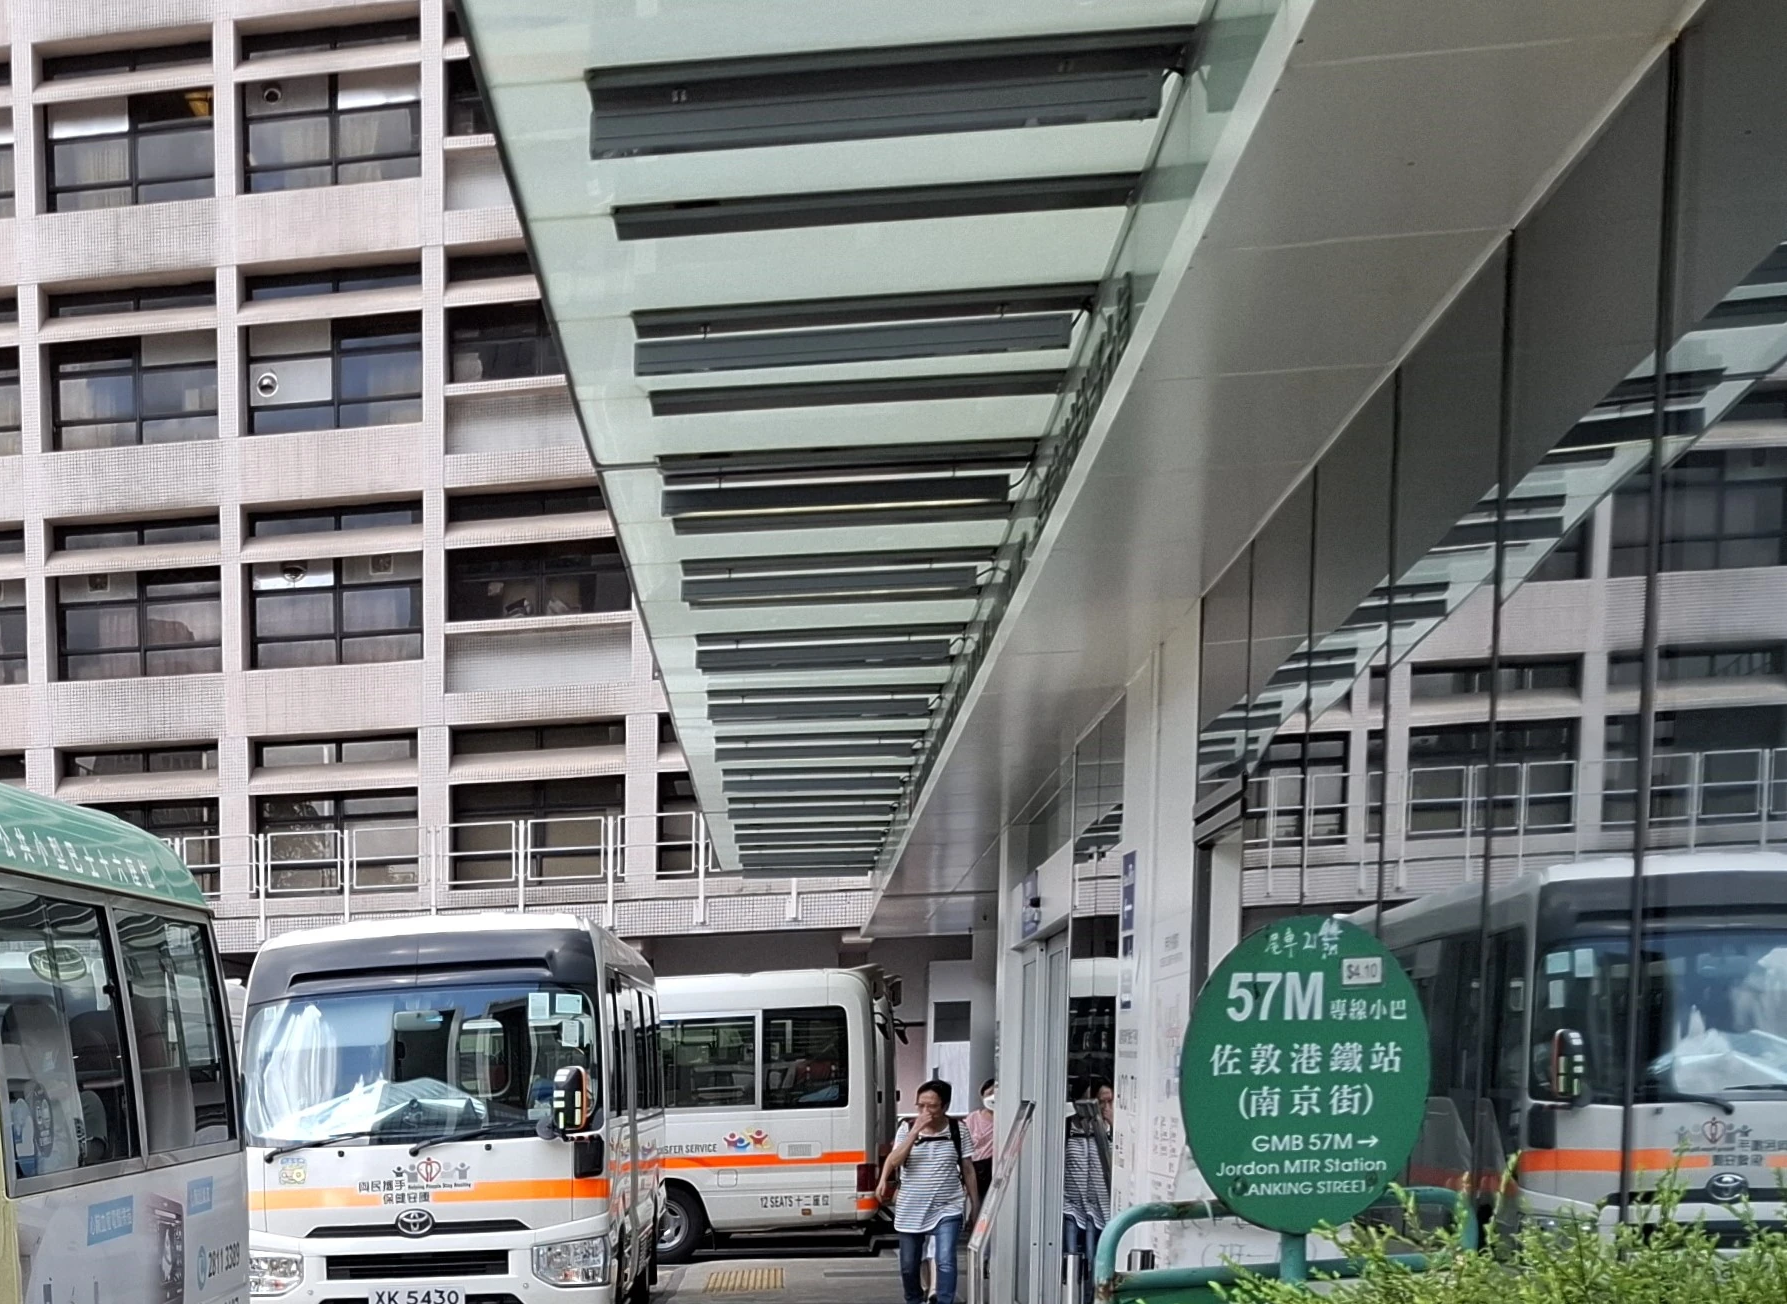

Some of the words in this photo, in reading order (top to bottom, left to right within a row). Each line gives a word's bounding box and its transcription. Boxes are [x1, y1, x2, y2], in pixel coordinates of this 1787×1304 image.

[1225, 971, 1324, 1022] 57M
[1329, 999, 1408, 1020] 專線小巴
[1209, 1041, 1402, 1077] 佐敦港鐵站
[1238, 1082, 1374, 1120] (南京街)
[685, 1143, 718, 1153] SERVICE
[1251, 1134, 1303, 1152] GMB
[1308, 1133, 1353, 1151] 57M
[1216, 1160, 1280, 1177] Jordan
[1283, 1160, 1321, 1174] MTR
[1324, 1157, 1387, 1172] Station
[1228, 1181, 1313, 1200] (ANKING
[760, 1197, 768, 1208] 12
[770, 1195, 794, 1208] SEATS
